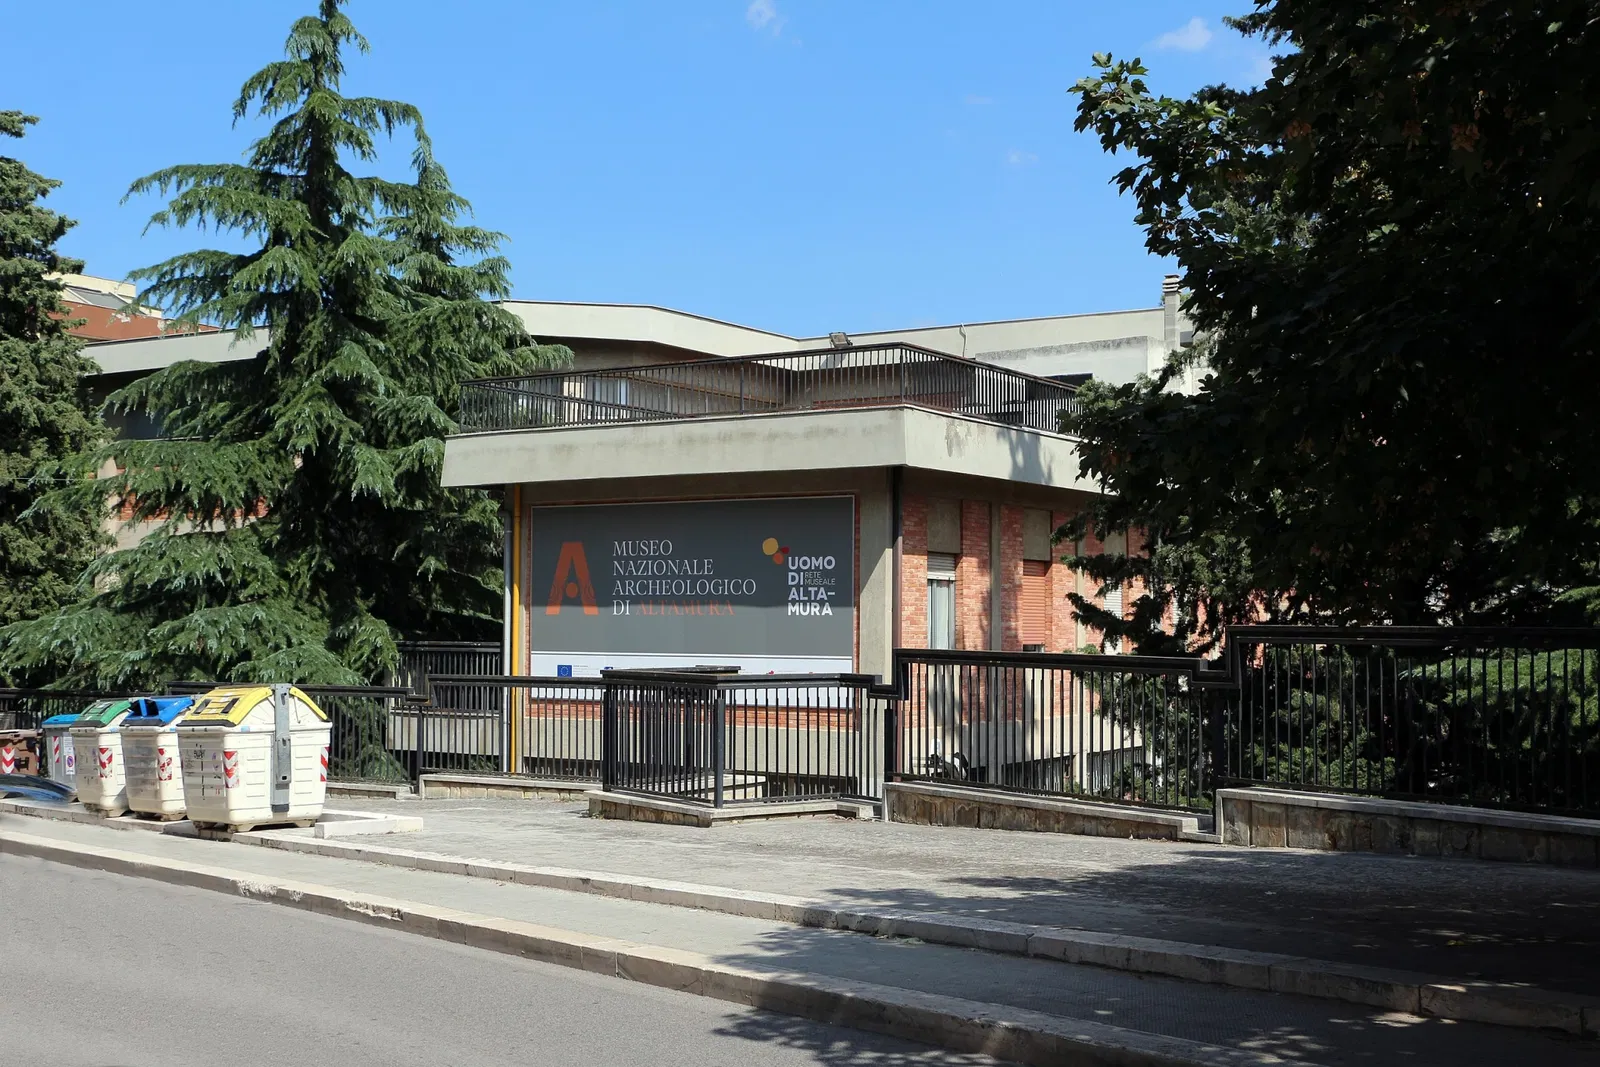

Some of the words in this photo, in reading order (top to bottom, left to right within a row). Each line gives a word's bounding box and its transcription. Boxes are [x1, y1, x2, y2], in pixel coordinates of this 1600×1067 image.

[613, 540, 673, 557] MUSEO
[613, 559, 714, 576] NAZIONALE
[788, 556, 836, 570] UOMO
[788, 572, 804, 586] DI
[612, 578, 757, 596] ARCHEOLOGICO
[788, 587, 836, 601] ALTA-
[613, 600, 630, 616] DI
[636, 600, 735, 616] ALTAMURA
[788, 602, 833, 616] MURA
